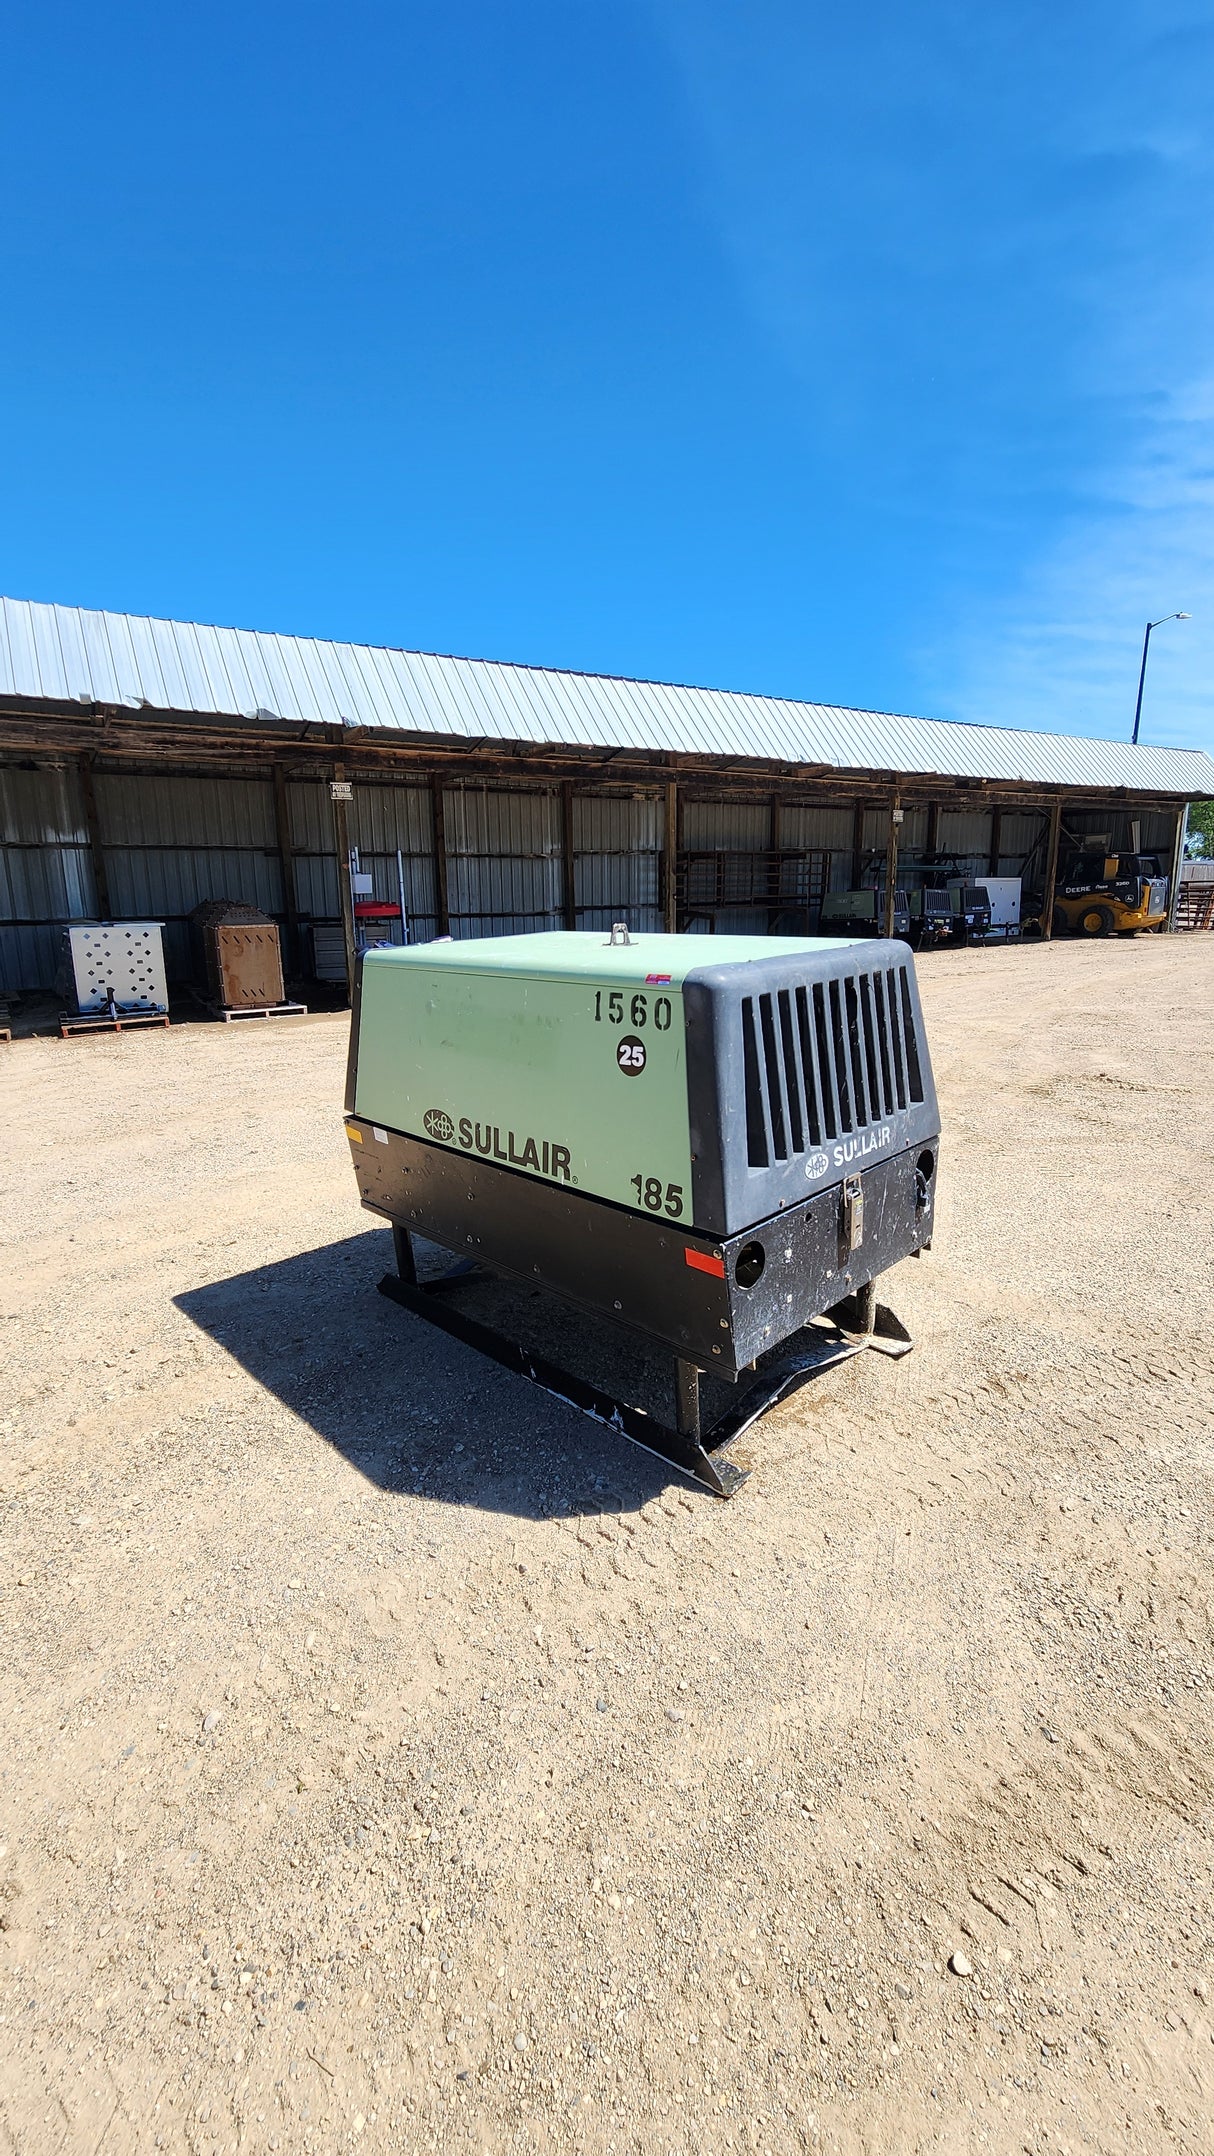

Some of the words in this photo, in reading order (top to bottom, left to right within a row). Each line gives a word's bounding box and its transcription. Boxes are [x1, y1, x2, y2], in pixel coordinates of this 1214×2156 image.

[1065, 886, 1091, 894] DEERE
[594, 991, 672, 1031] 1560
[619, 1045, 645, 1067] 25
[458, 1117, 571, 1181] SULLAIR
[833, 1126, 891, 1167] SULLAIR
[630, 1174, 684, 1218] 185
